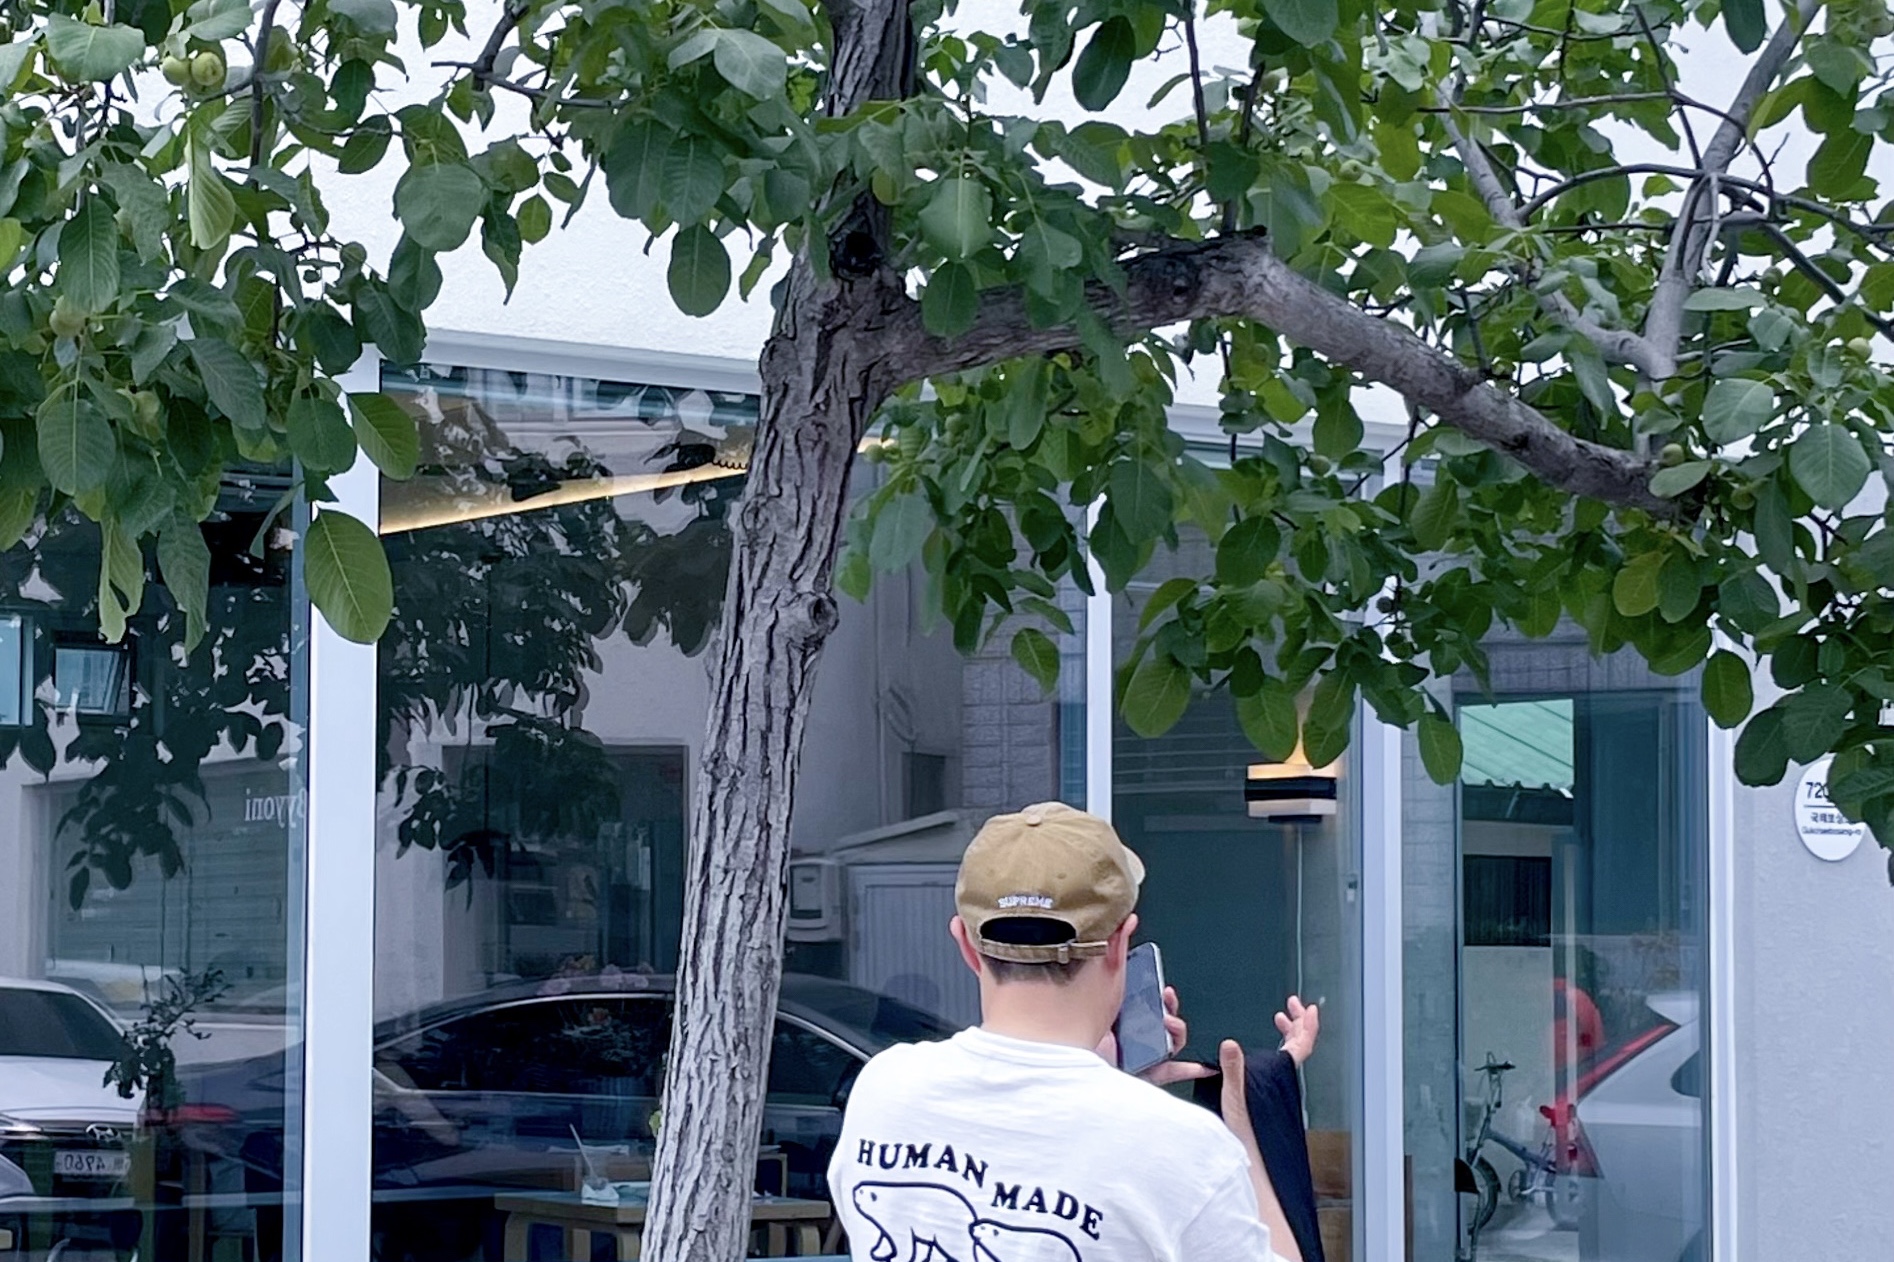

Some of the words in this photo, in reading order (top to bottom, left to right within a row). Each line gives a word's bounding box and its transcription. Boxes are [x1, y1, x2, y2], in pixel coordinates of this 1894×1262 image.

[997, 894, 1053, 909] SUPREME
[857, 1139, 989, 1188] HUMAN
[991, 1182, 1103, 1241] MADE
